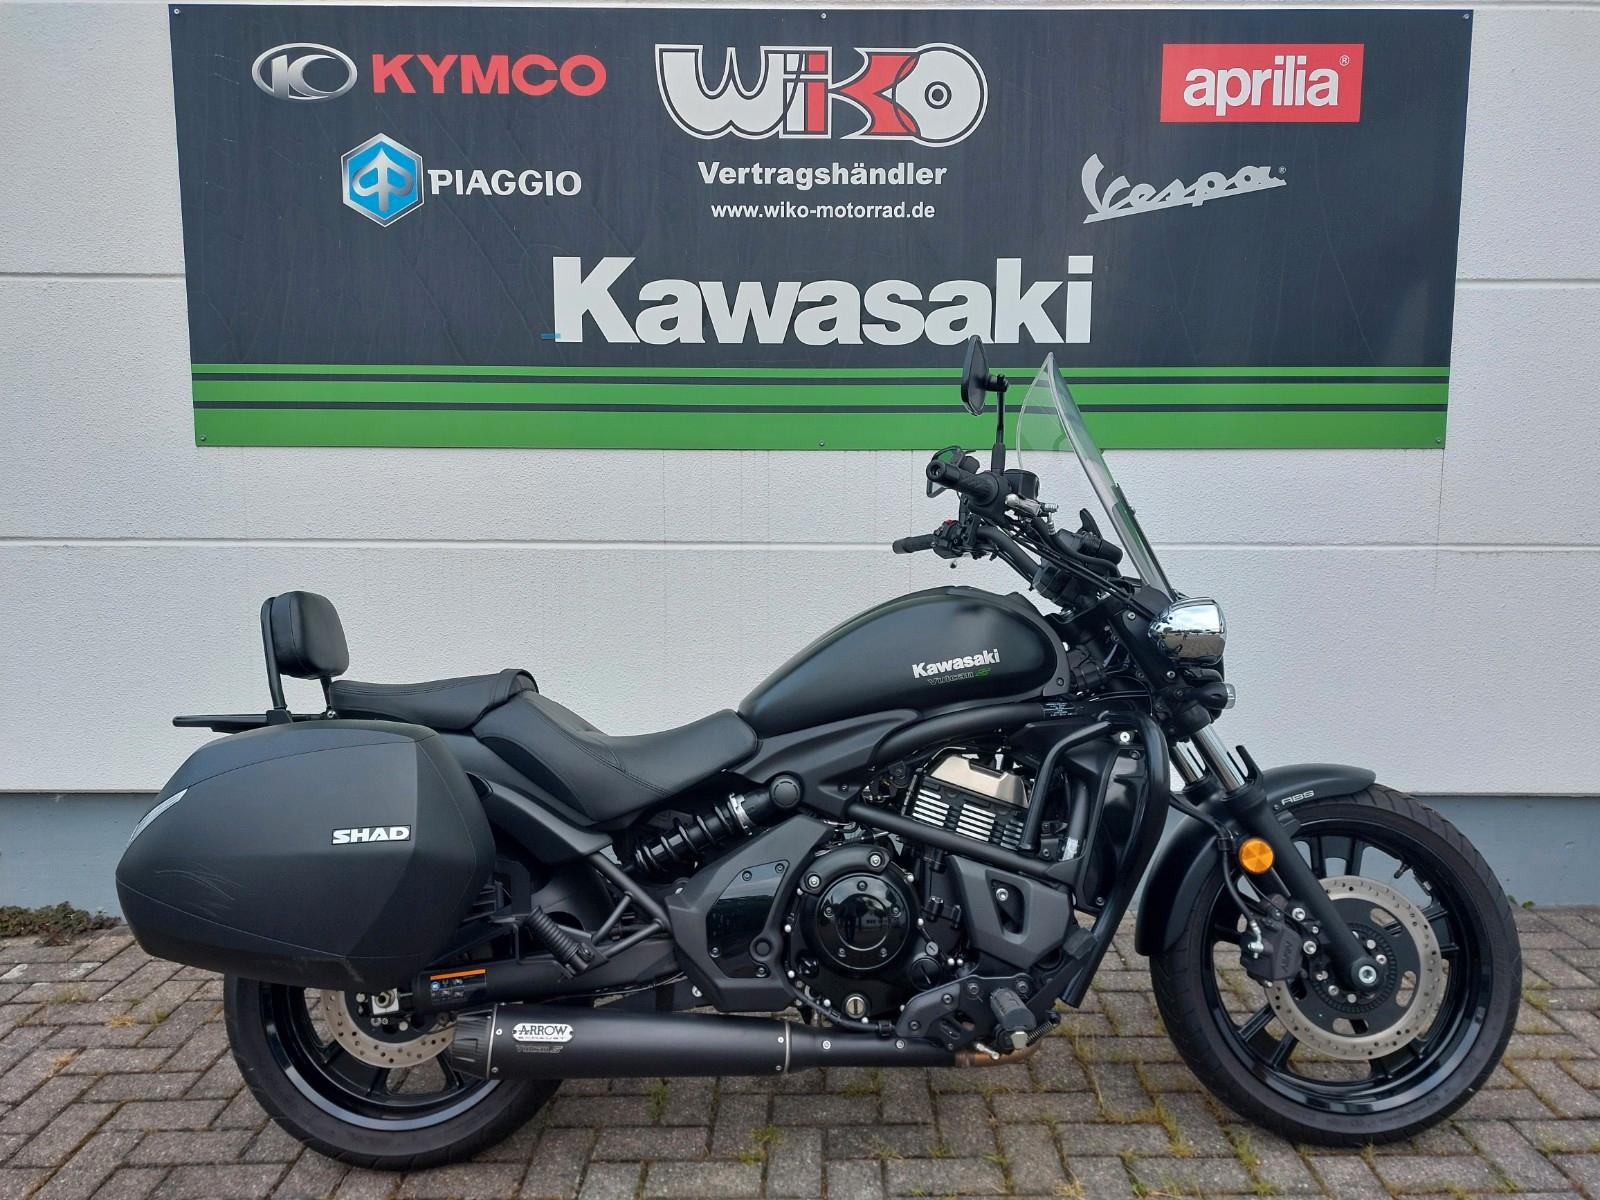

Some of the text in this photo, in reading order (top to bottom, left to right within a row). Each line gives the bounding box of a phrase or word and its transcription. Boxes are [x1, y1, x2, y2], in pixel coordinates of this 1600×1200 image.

[371, 53, 607, 97] KYMCO
[1183, 55, 1339, 117] aprilia
[427, 169, 582, 196] PIAGGIO
[697, 161, 948, 191] Vertragshändler
[1081, 153, 1287, 224] Vespa
[710, 201, 936, 219] www.wiko-motorrad.de
[552, 255, 1094, 346] Kawasaki
[911, 648, 1000, 679] Kawasaki
[1281, 790, 1315, 806] ABS
[332, 826, 410, 845] SHAD
[519, 1025, 568, 1036] ARROW
